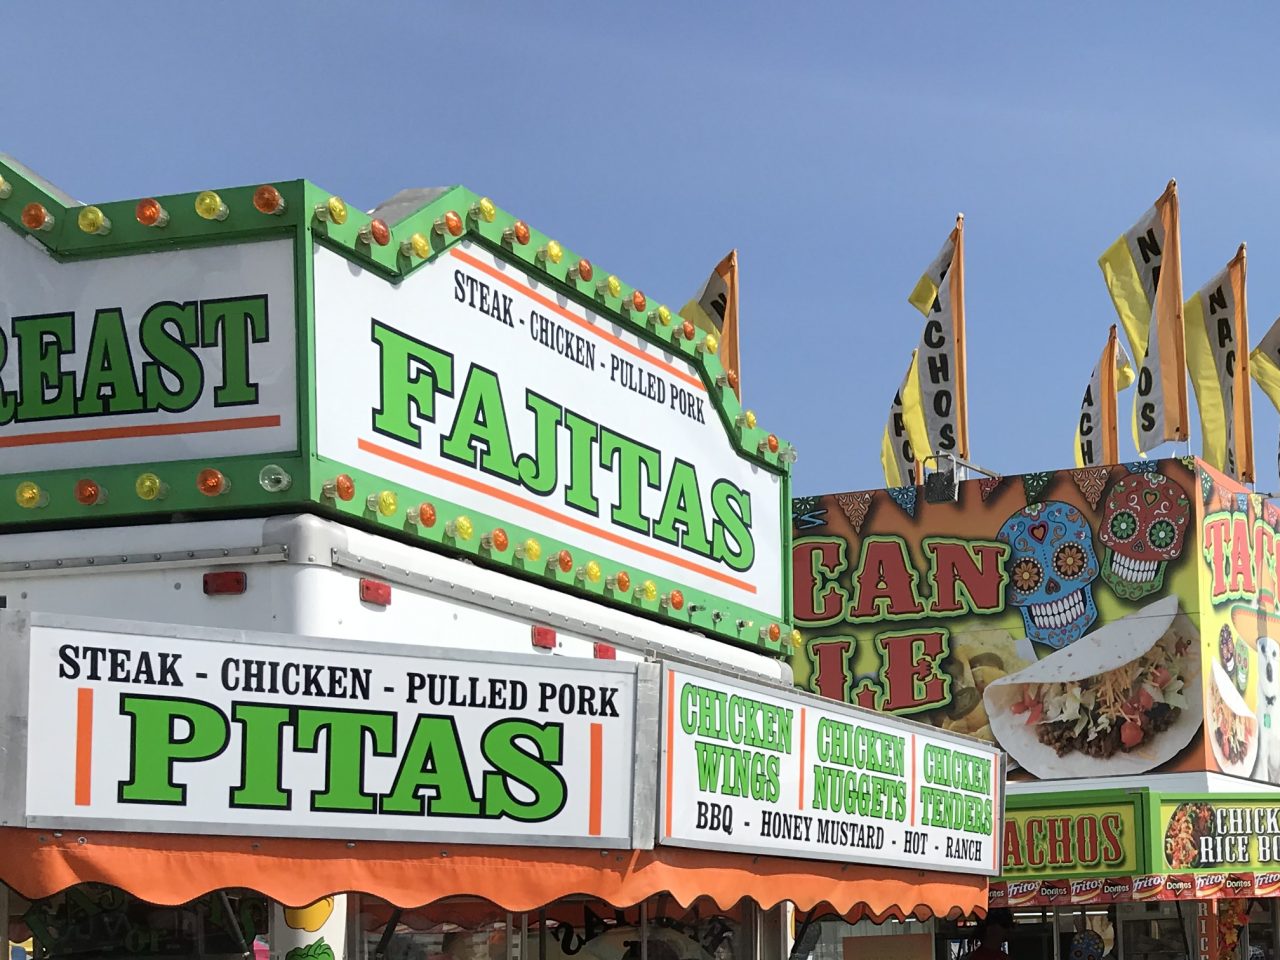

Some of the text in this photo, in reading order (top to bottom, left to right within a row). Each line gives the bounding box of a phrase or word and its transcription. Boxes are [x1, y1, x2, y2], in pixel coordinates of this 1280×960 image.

[0, 293, 269, 426] EAST
[453, 268, 515, 330] STEAK
[529, 308, 598, 372] CHICKEN
[610, 352, 666, 406] PULLED
[670, 389, 706, 426] PORK
[370, 317, 756, 573] FAJITAS
[58, 643, 185, 687] STEAK
[220, 657, 373, 700] CHICKEN
[406, 672, 529, 711] PULLED
[537, 681, 621, 718] PORK
[680, 682, 794, 754] CHICKEN
[816, 716, 906, 778] CHICKEN
[117, 692, 568, 823] PITAS
[695, 740, 781, 803] WINGS
[923, 742, 992, 796] CHICKEN
[812, 764, 907, 823] NUGGETS
[920, 785, 993, 836] TENDERS
[696, 800, 733, 834] BBQ
[760, 810, 813, 843] HONEY
[816, 818, 885, 850] MUSTARD
[903, 830, 928, 855] HOT
[945, 836, 983, 861] RANCH
[1002, 813, 1122, 867] ACHOS
[1199, 836, 1250, 863] RICE
[989, 889, 1005, 898] ritos
[1041, 886, 1067, 896] Doritos
[1104, 885, 1130, 894] Doritos
[1166, 881, 1192, 890] Doritos
[1226, 880, 1252, 888] Doritos
